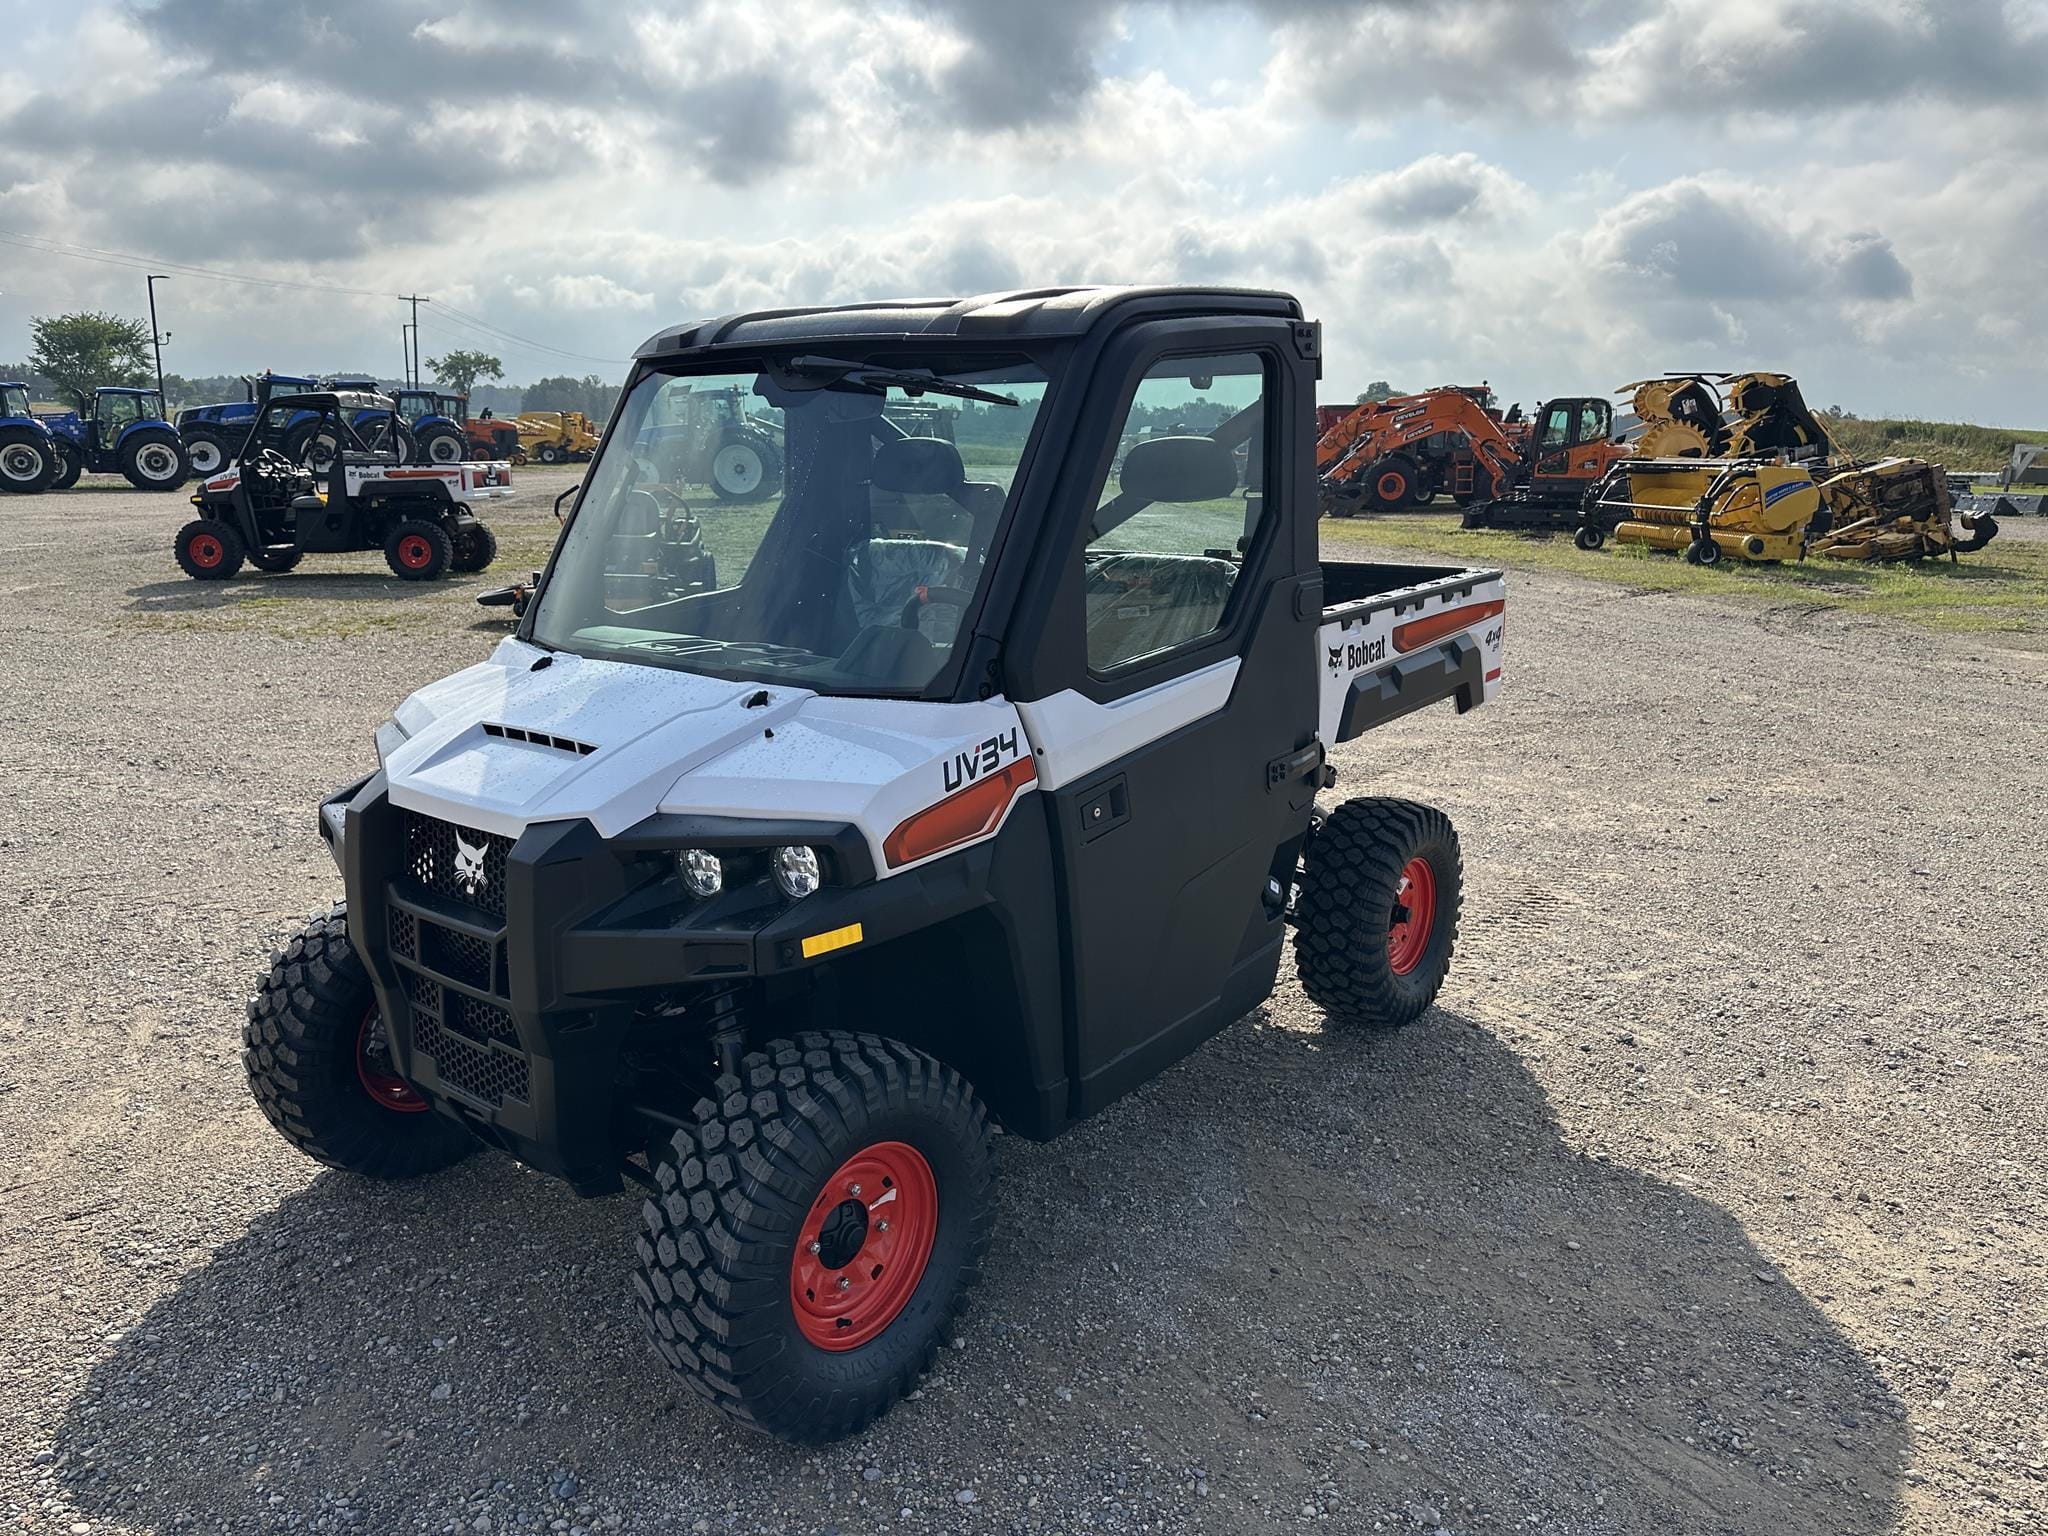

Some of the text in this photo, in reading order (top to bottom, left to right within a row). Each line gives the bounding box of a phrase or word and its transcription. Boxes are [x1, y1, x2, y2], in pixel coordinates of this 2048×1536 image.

[358, 471, 380, 480] Bobcat
[1485, 624, 1503, 647] 4x4
[1347, 634, 1386, 671] Bobcat
[943, 726, 1018, 793] UV34
